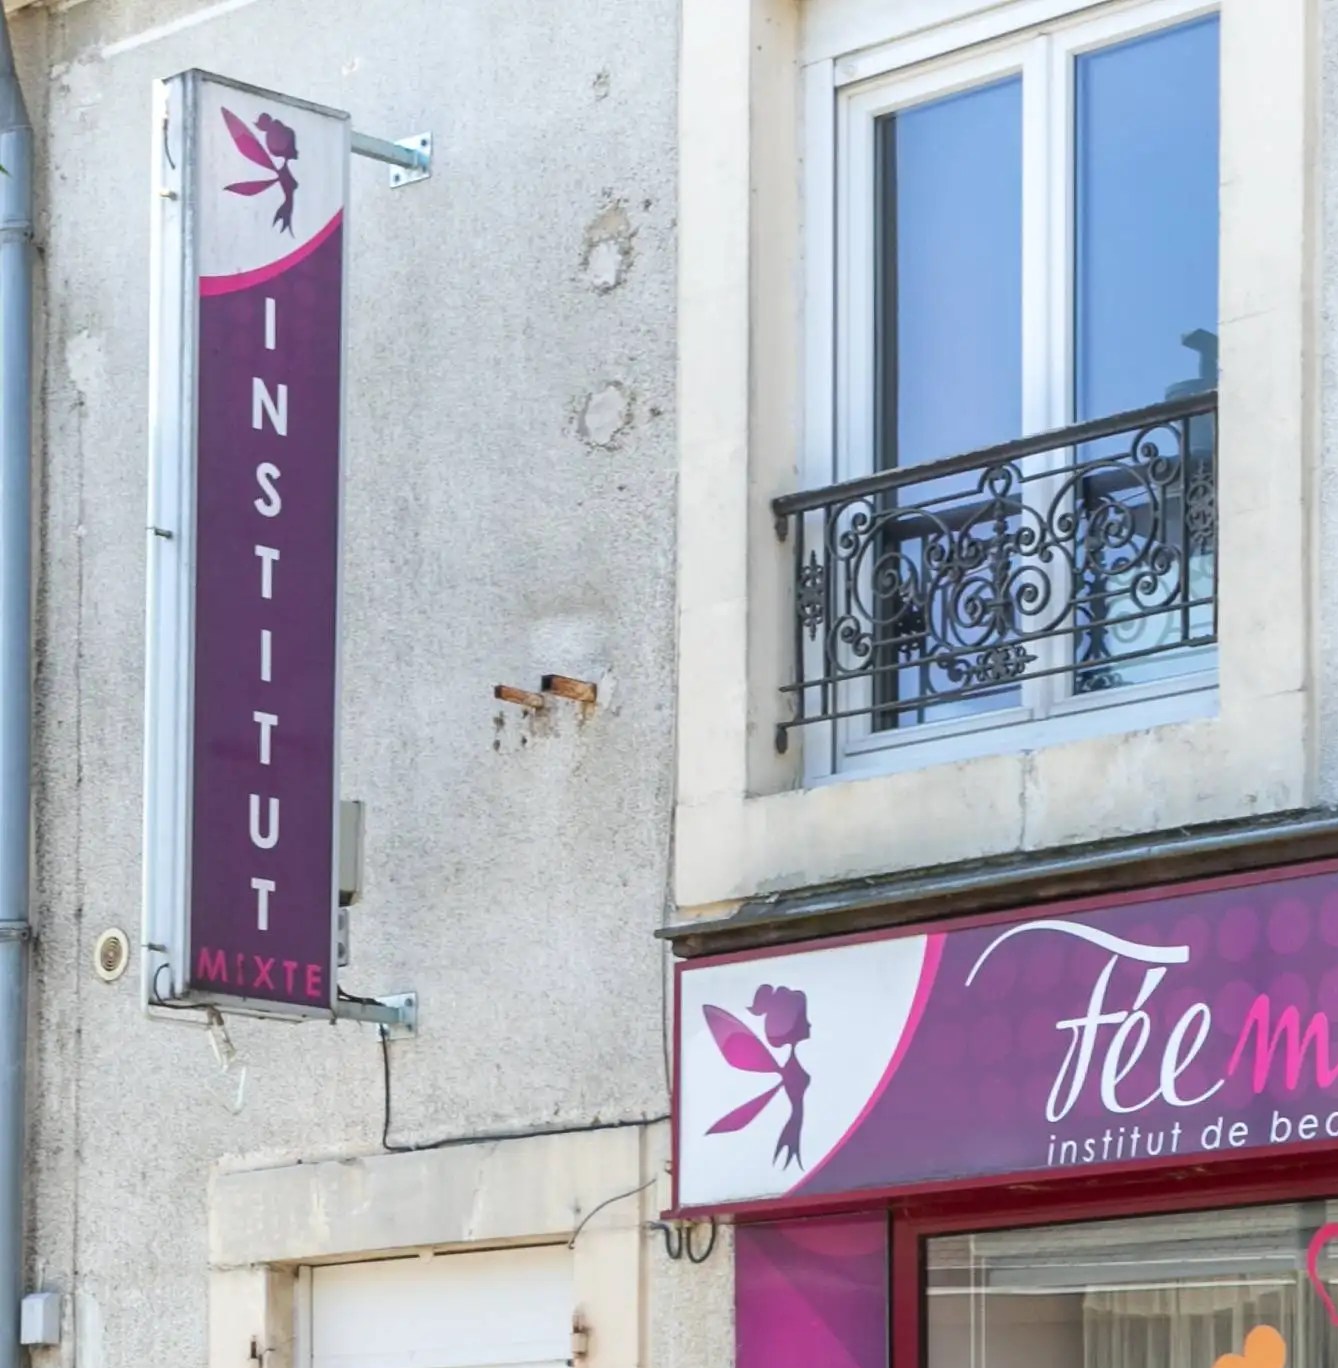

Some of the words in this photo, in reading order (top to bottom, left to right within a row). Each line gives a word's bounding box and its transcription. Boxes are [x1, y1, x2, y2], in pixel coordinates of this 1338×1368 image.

[249, 297, 289, 932] INSTITUT
[197, 946, 323, 997] MIXTE
[1046, 1124, 1183, 1167] institut
[1200, 1114, 1249, 1150] de
